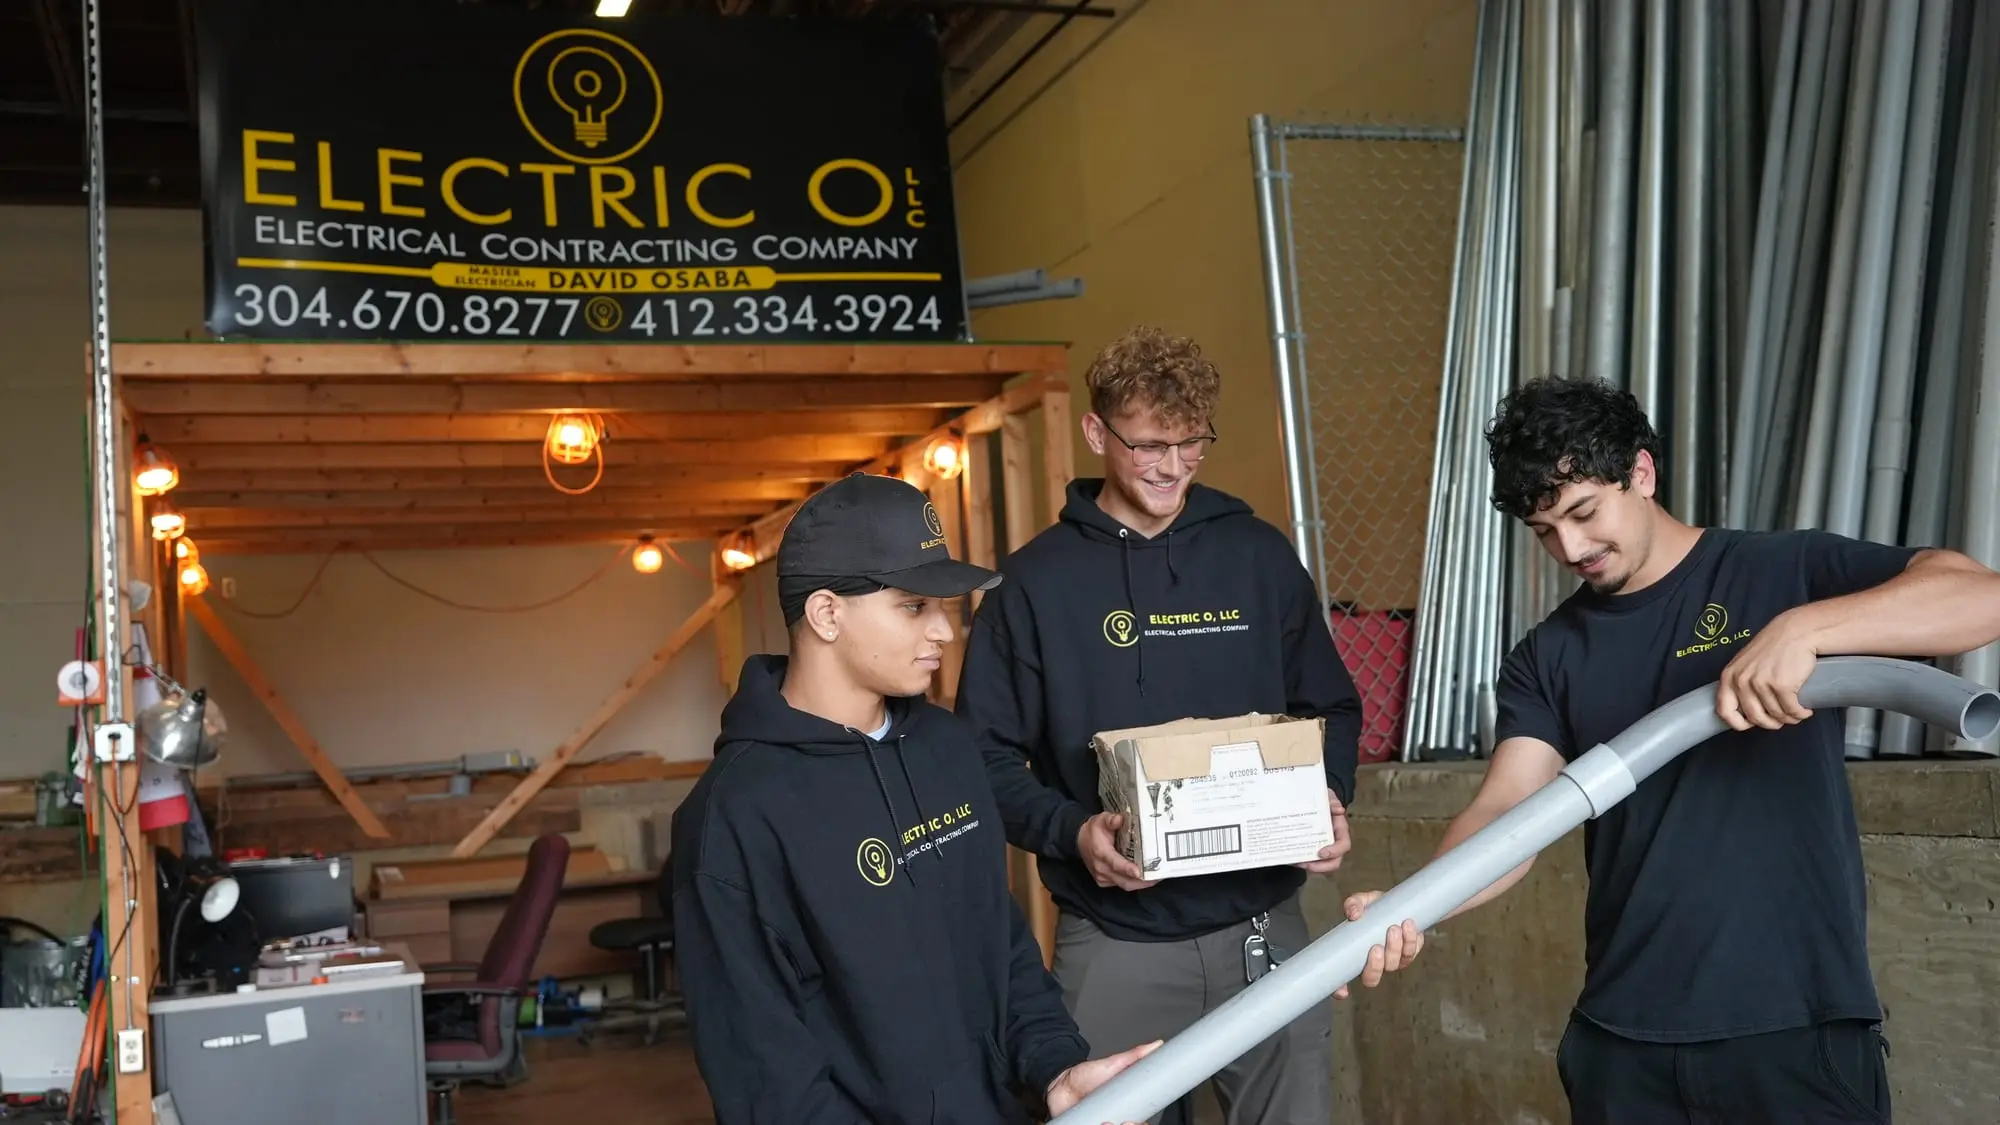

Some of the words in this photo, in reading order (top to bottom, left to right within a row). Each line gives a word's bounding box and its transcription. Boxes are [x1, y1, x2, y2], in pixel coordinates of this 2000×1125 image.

[243, 128, 755, 228] ELECTRIC
[807, 158, 894, 227] O
[905, 167, 926, 228] LLC
[255, 215, 466, 257] ELECTRICAL
[480, 233, 738, 264] CONTRACTING
[752, 235, 918, 261] COMPANY
[455, 275, 536, 288] ELECTRICIAN
[469, 265, 520, 277] MASTER
[550, 270, 638, 290] DAVID
[651, 269, 752, 290] OSABA
[234, 283, 580, 336] 304.670.8277
[630, 294, 942, 336] 412.334.3924
[1144, 628, 1176, 636] ELECTRICAL
[1177, 626, 1221, 636] CONTRACTING
[1222, 624, 1249, 632] COMPANY
[1149, 612, 1200, 625] ELECTRIC
[1203, 611, 1216, 623] O,
[1219, 609, 1240, 621] LLC
[1676, 639, 1718, 658] ELECTRIC
[1734, 629, 1751, 641] LLC
[902, 817, 942, 846] LECTIC
[956, 804, 972, 819] LLC
